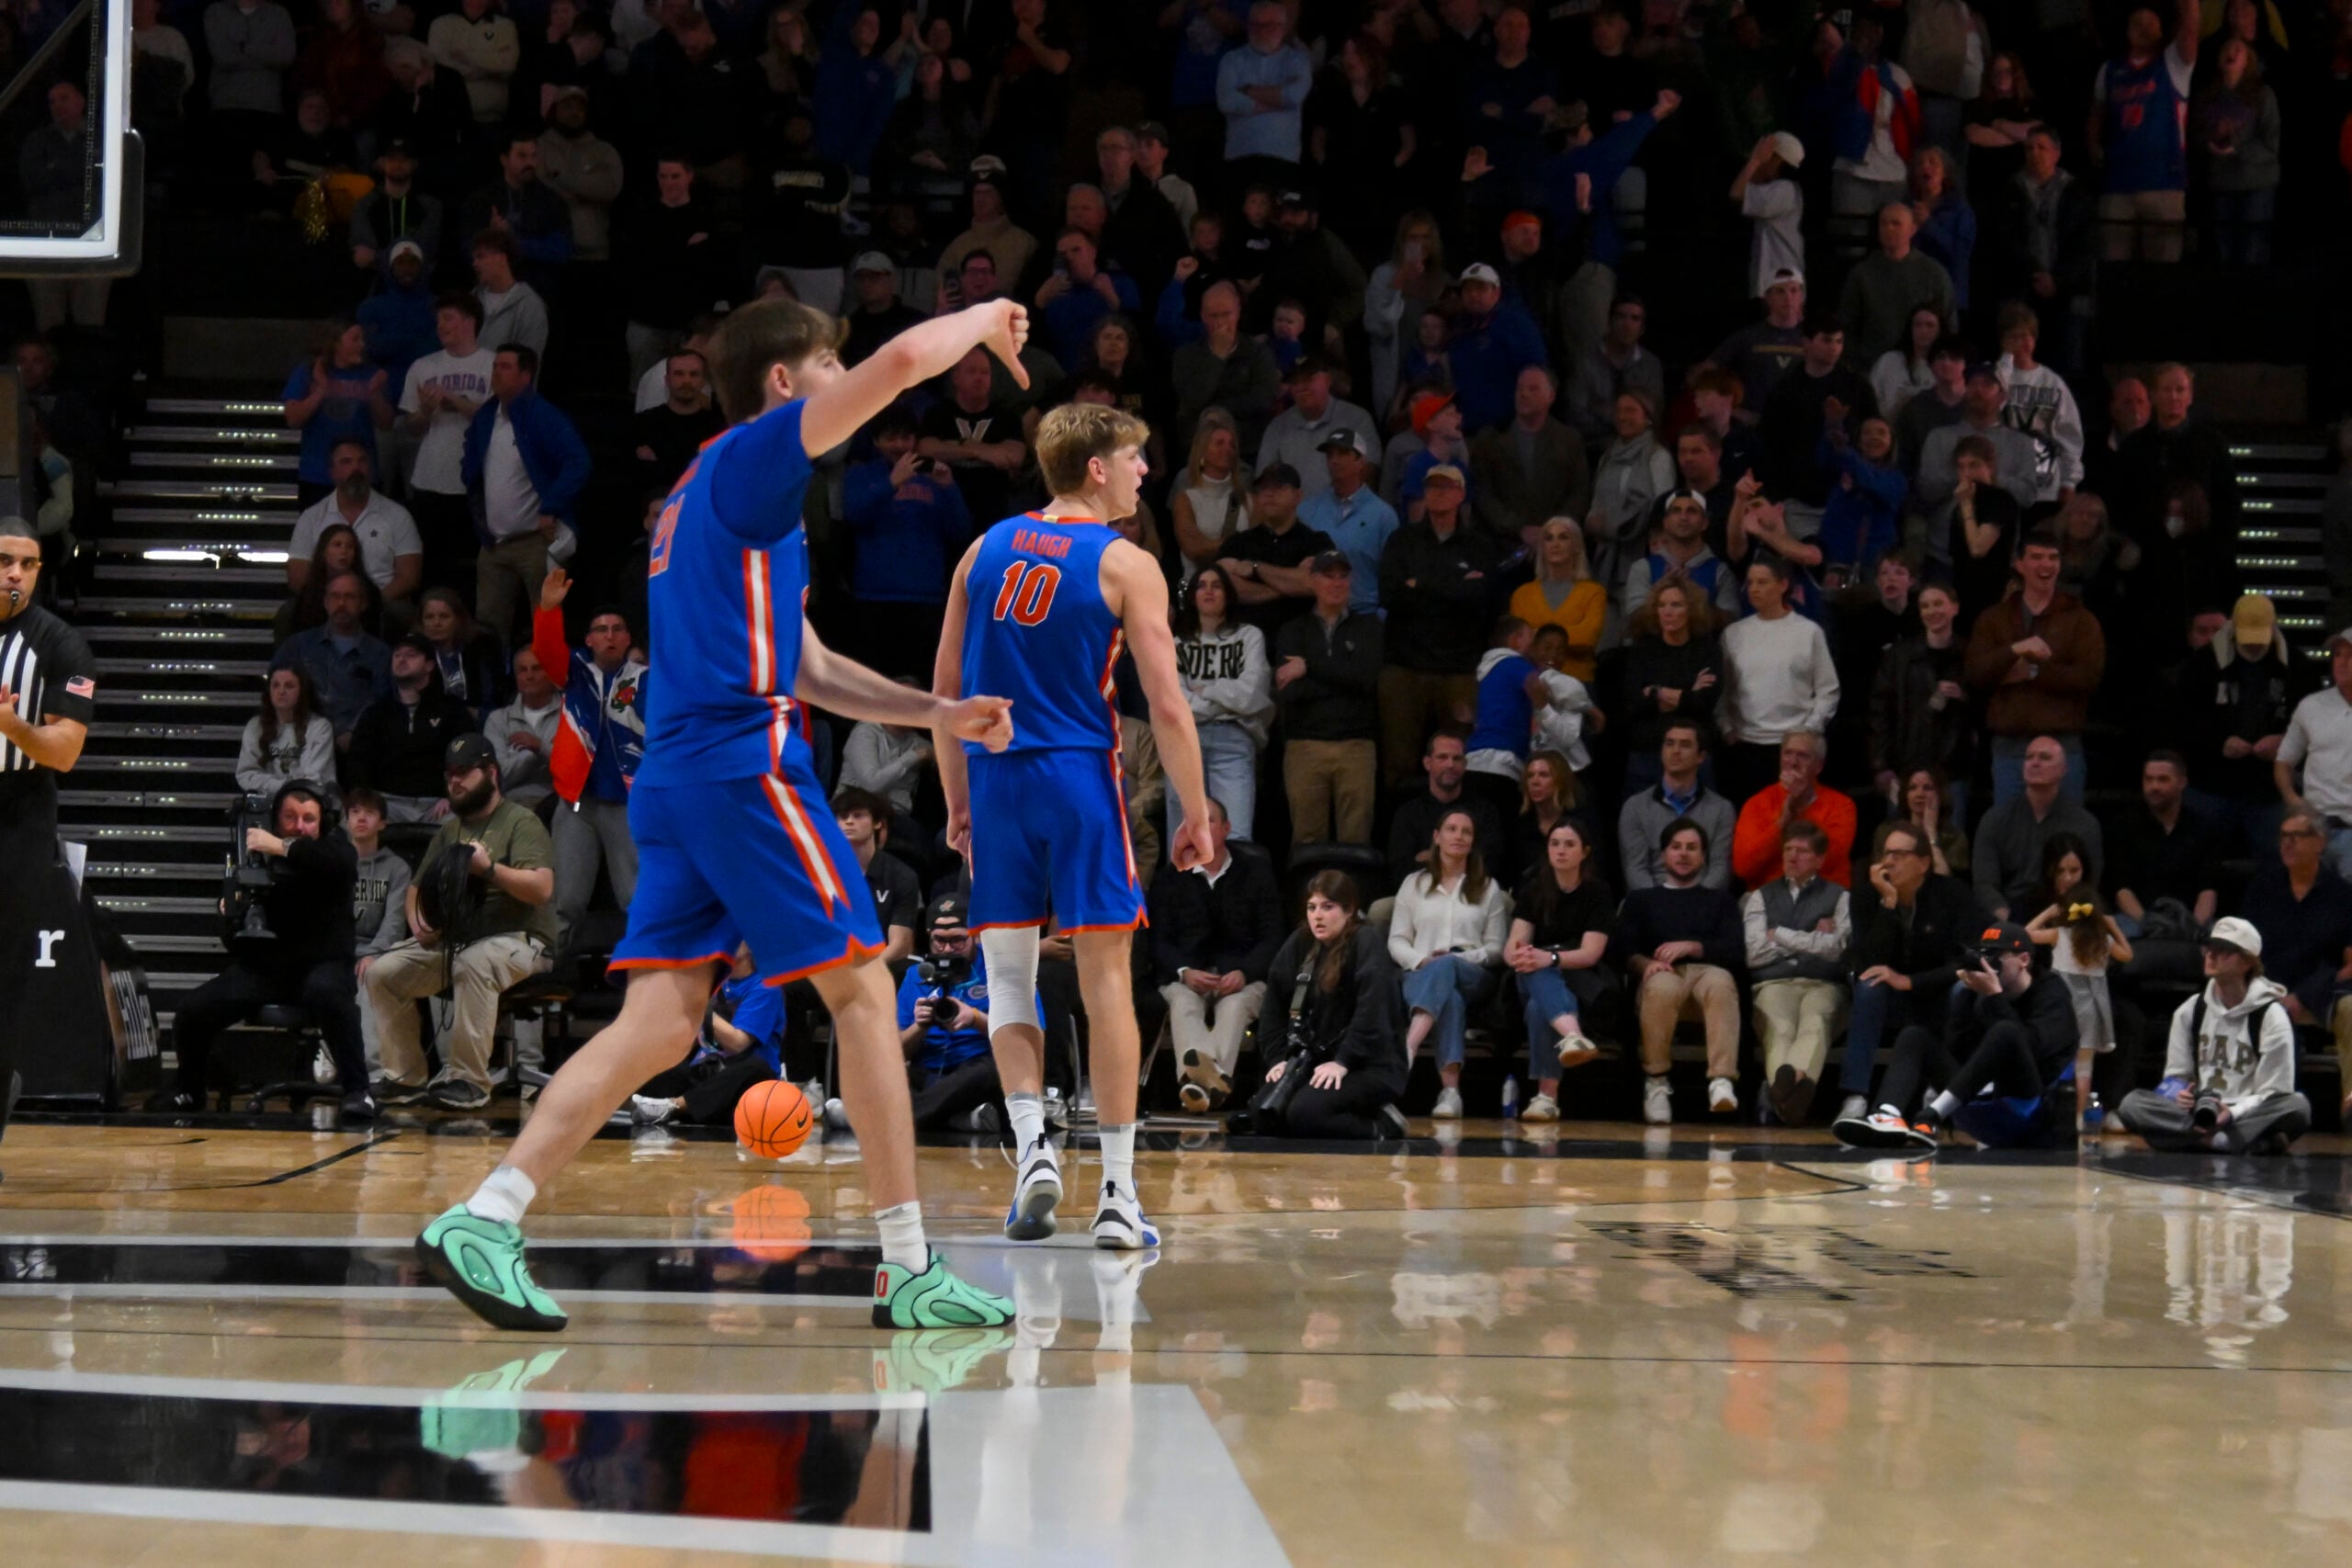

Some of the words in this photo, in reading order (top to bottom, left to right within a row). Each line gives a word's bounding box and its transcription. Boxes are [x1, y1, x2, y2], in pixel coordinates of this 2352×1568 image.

[424, 372, 487, 395] ORIDA
[1011, 528, 1073, 559] HAUGH
[993, 559, 1062, 626] 10
[876, 889, 890, 904] V
[34, 929, 66, 968] r
